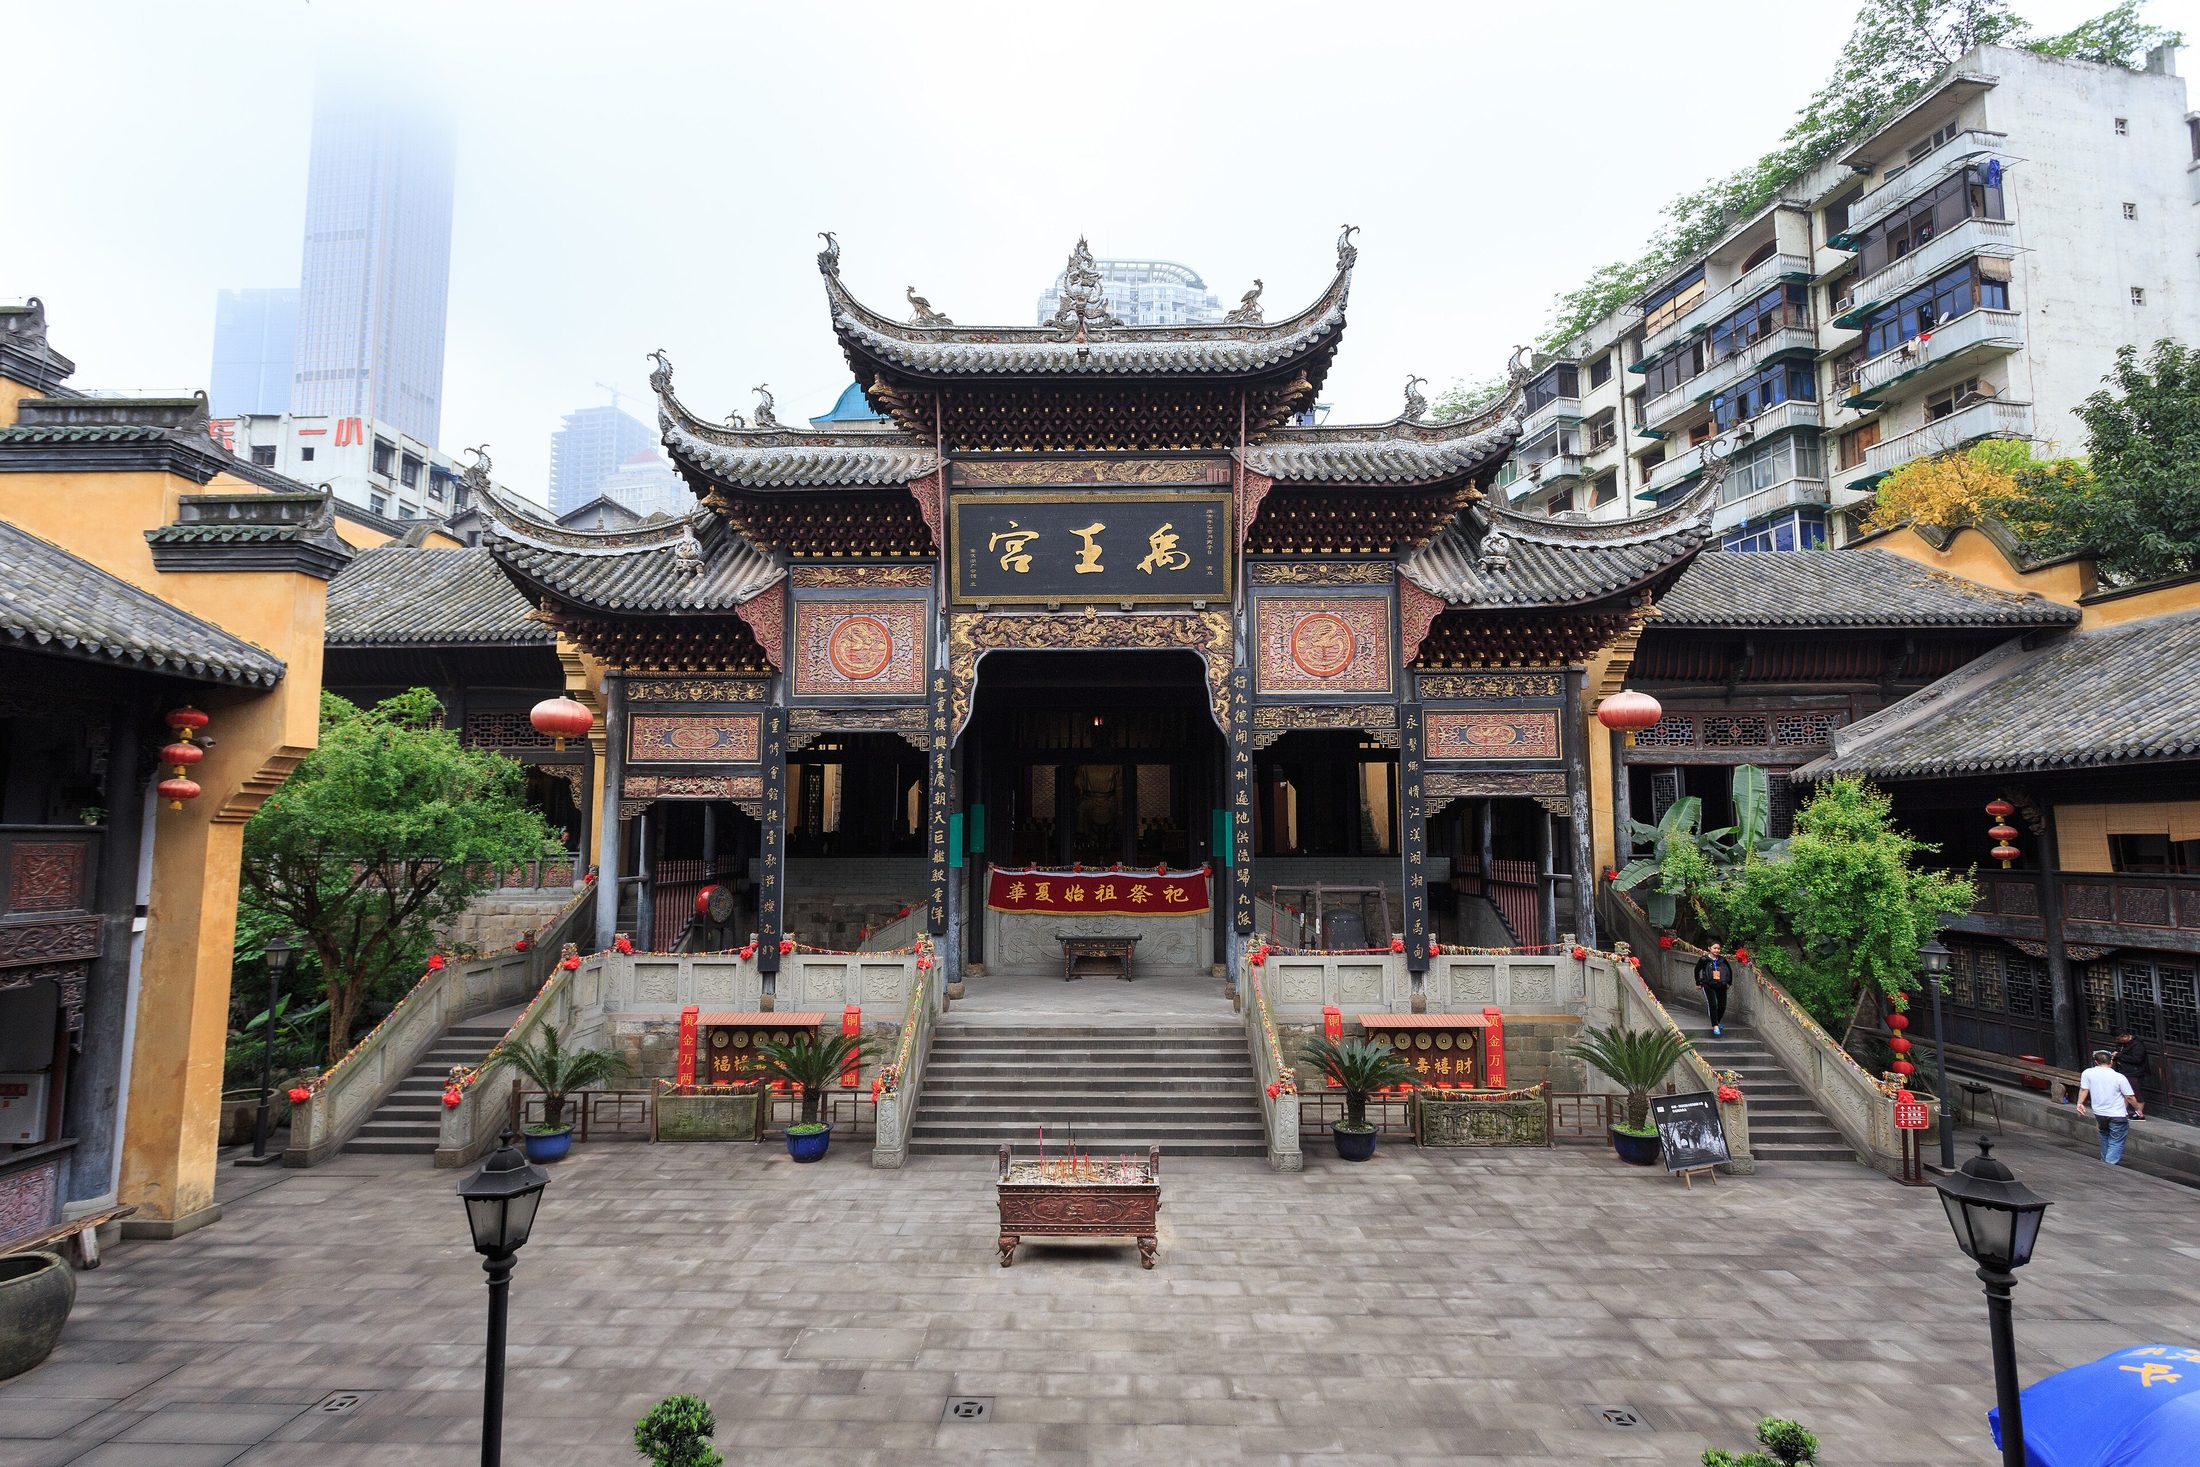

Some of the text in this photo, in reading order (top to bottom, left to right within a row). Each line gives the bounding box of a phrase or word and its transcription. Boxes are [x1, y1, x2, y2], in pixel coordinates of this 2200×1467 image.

[1006, 881, 1189, 904] 華夏始祖祭祀
[680, 1014, 696, 1085] 黄金万两
[844, 1014, 858, 1086] 铜一响
[1488, 1014, 1503, 1086] 黄金万两
